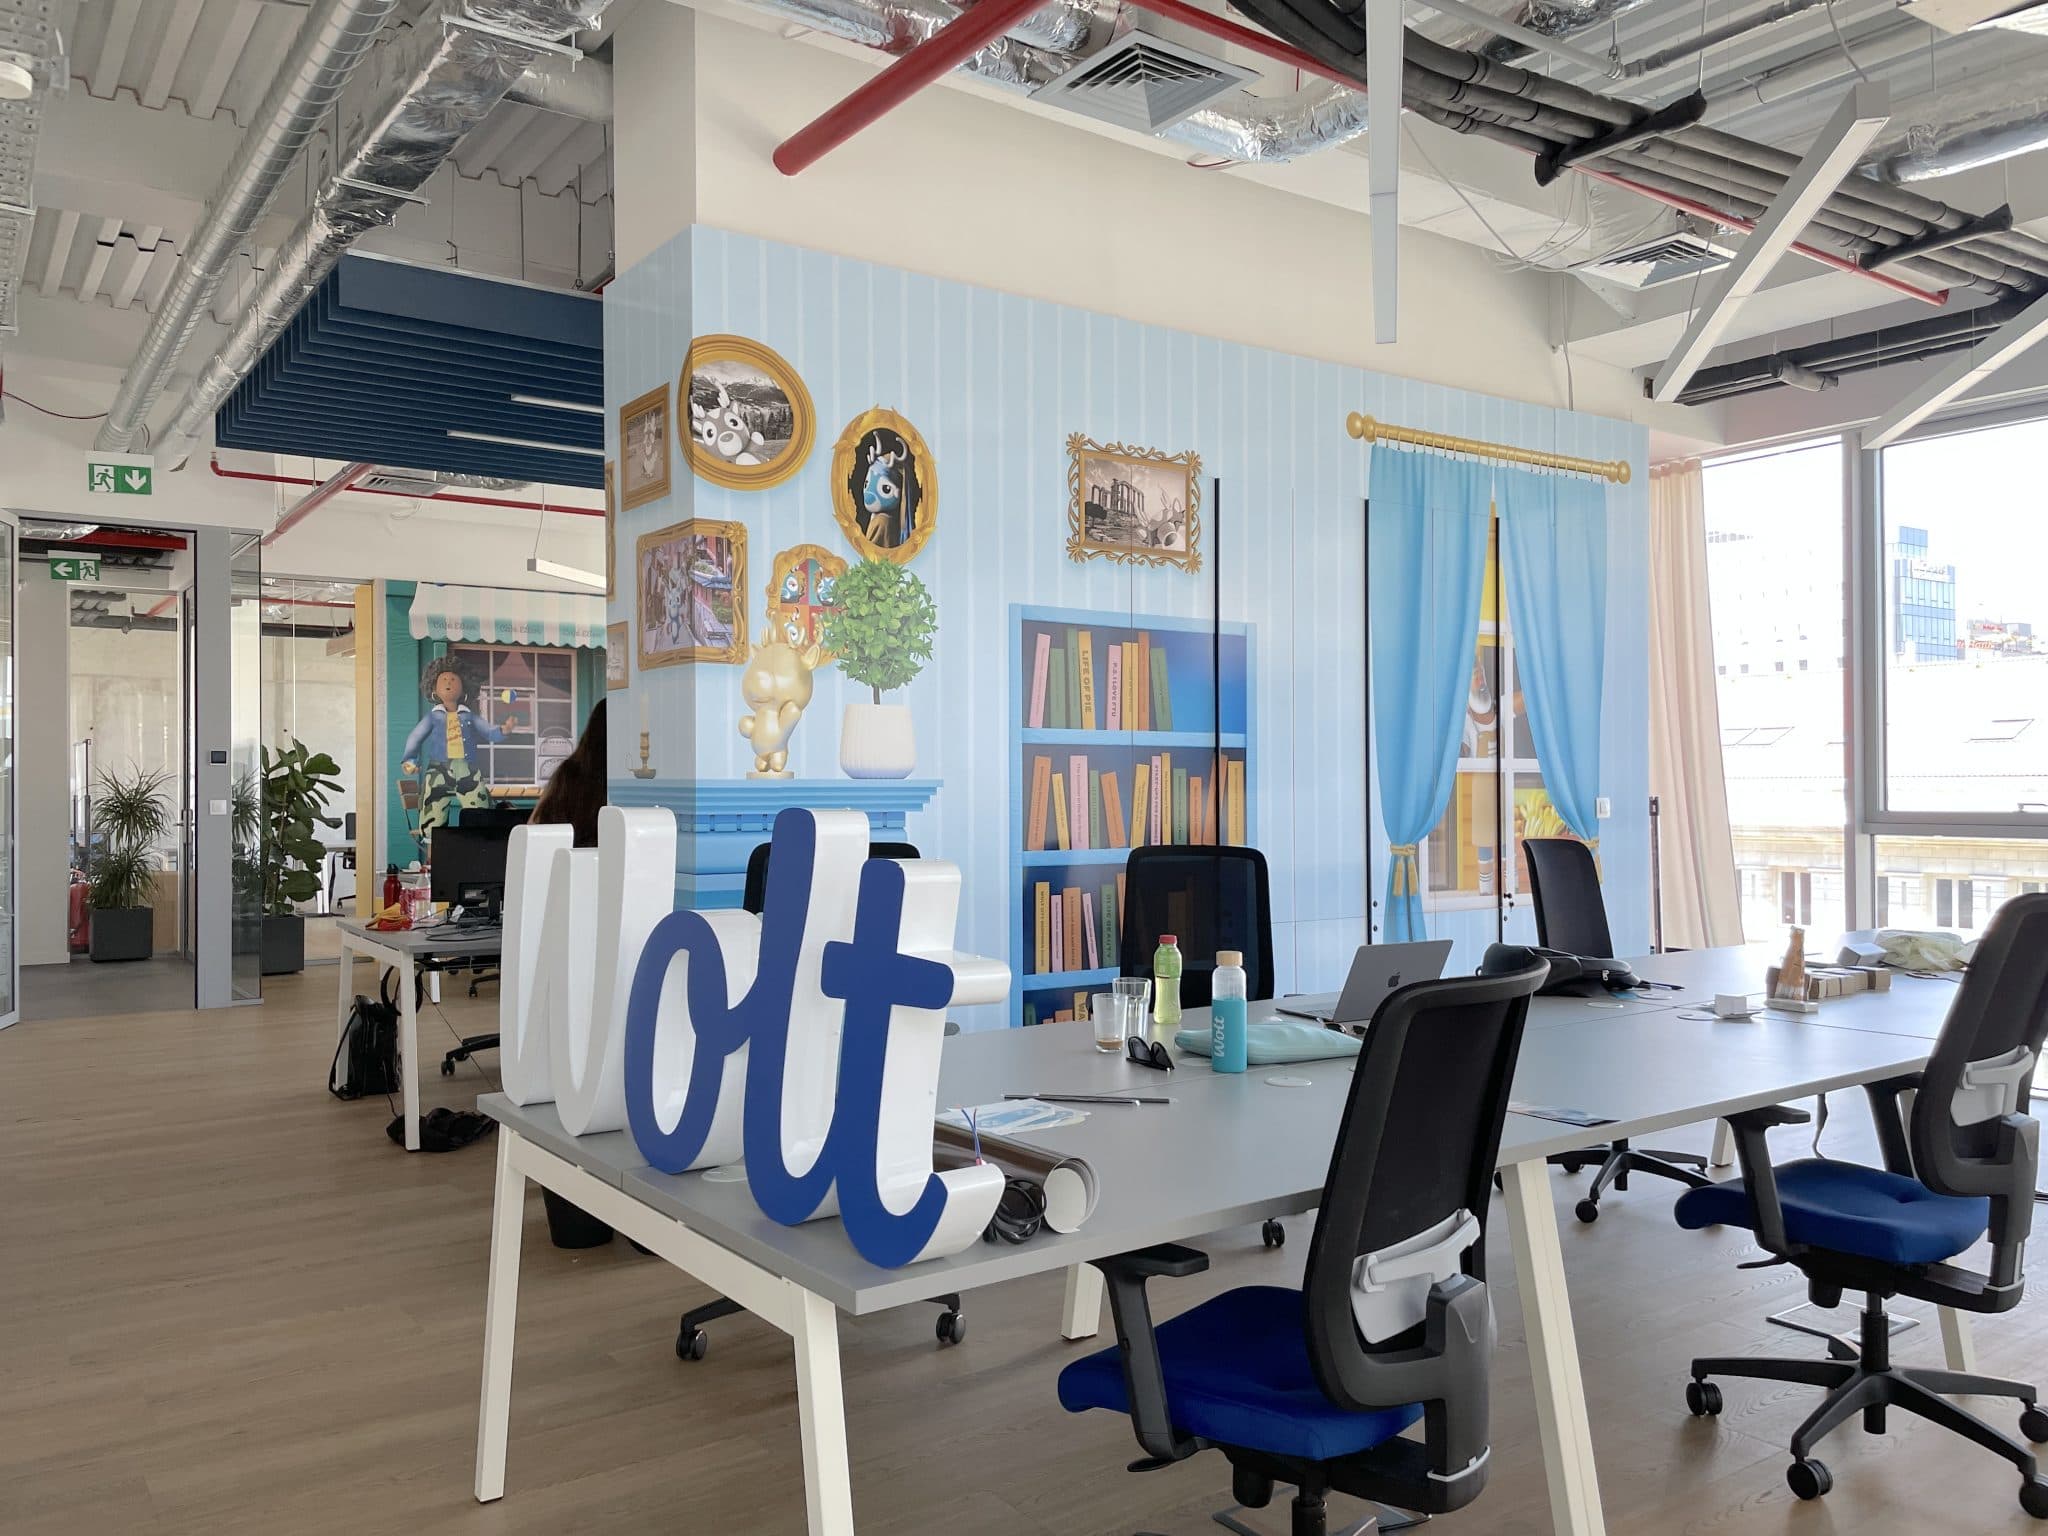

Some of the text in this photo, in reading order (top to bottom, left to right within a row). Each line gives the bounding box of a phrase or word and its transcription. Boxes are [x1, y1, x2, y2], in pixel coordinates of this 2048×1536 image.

[1081, 650, 1092, 714] LIFE OF PIE
[500, 806, 1008, 1269] Wolt
[1213, 1015, 1226, 1058] Wolt
